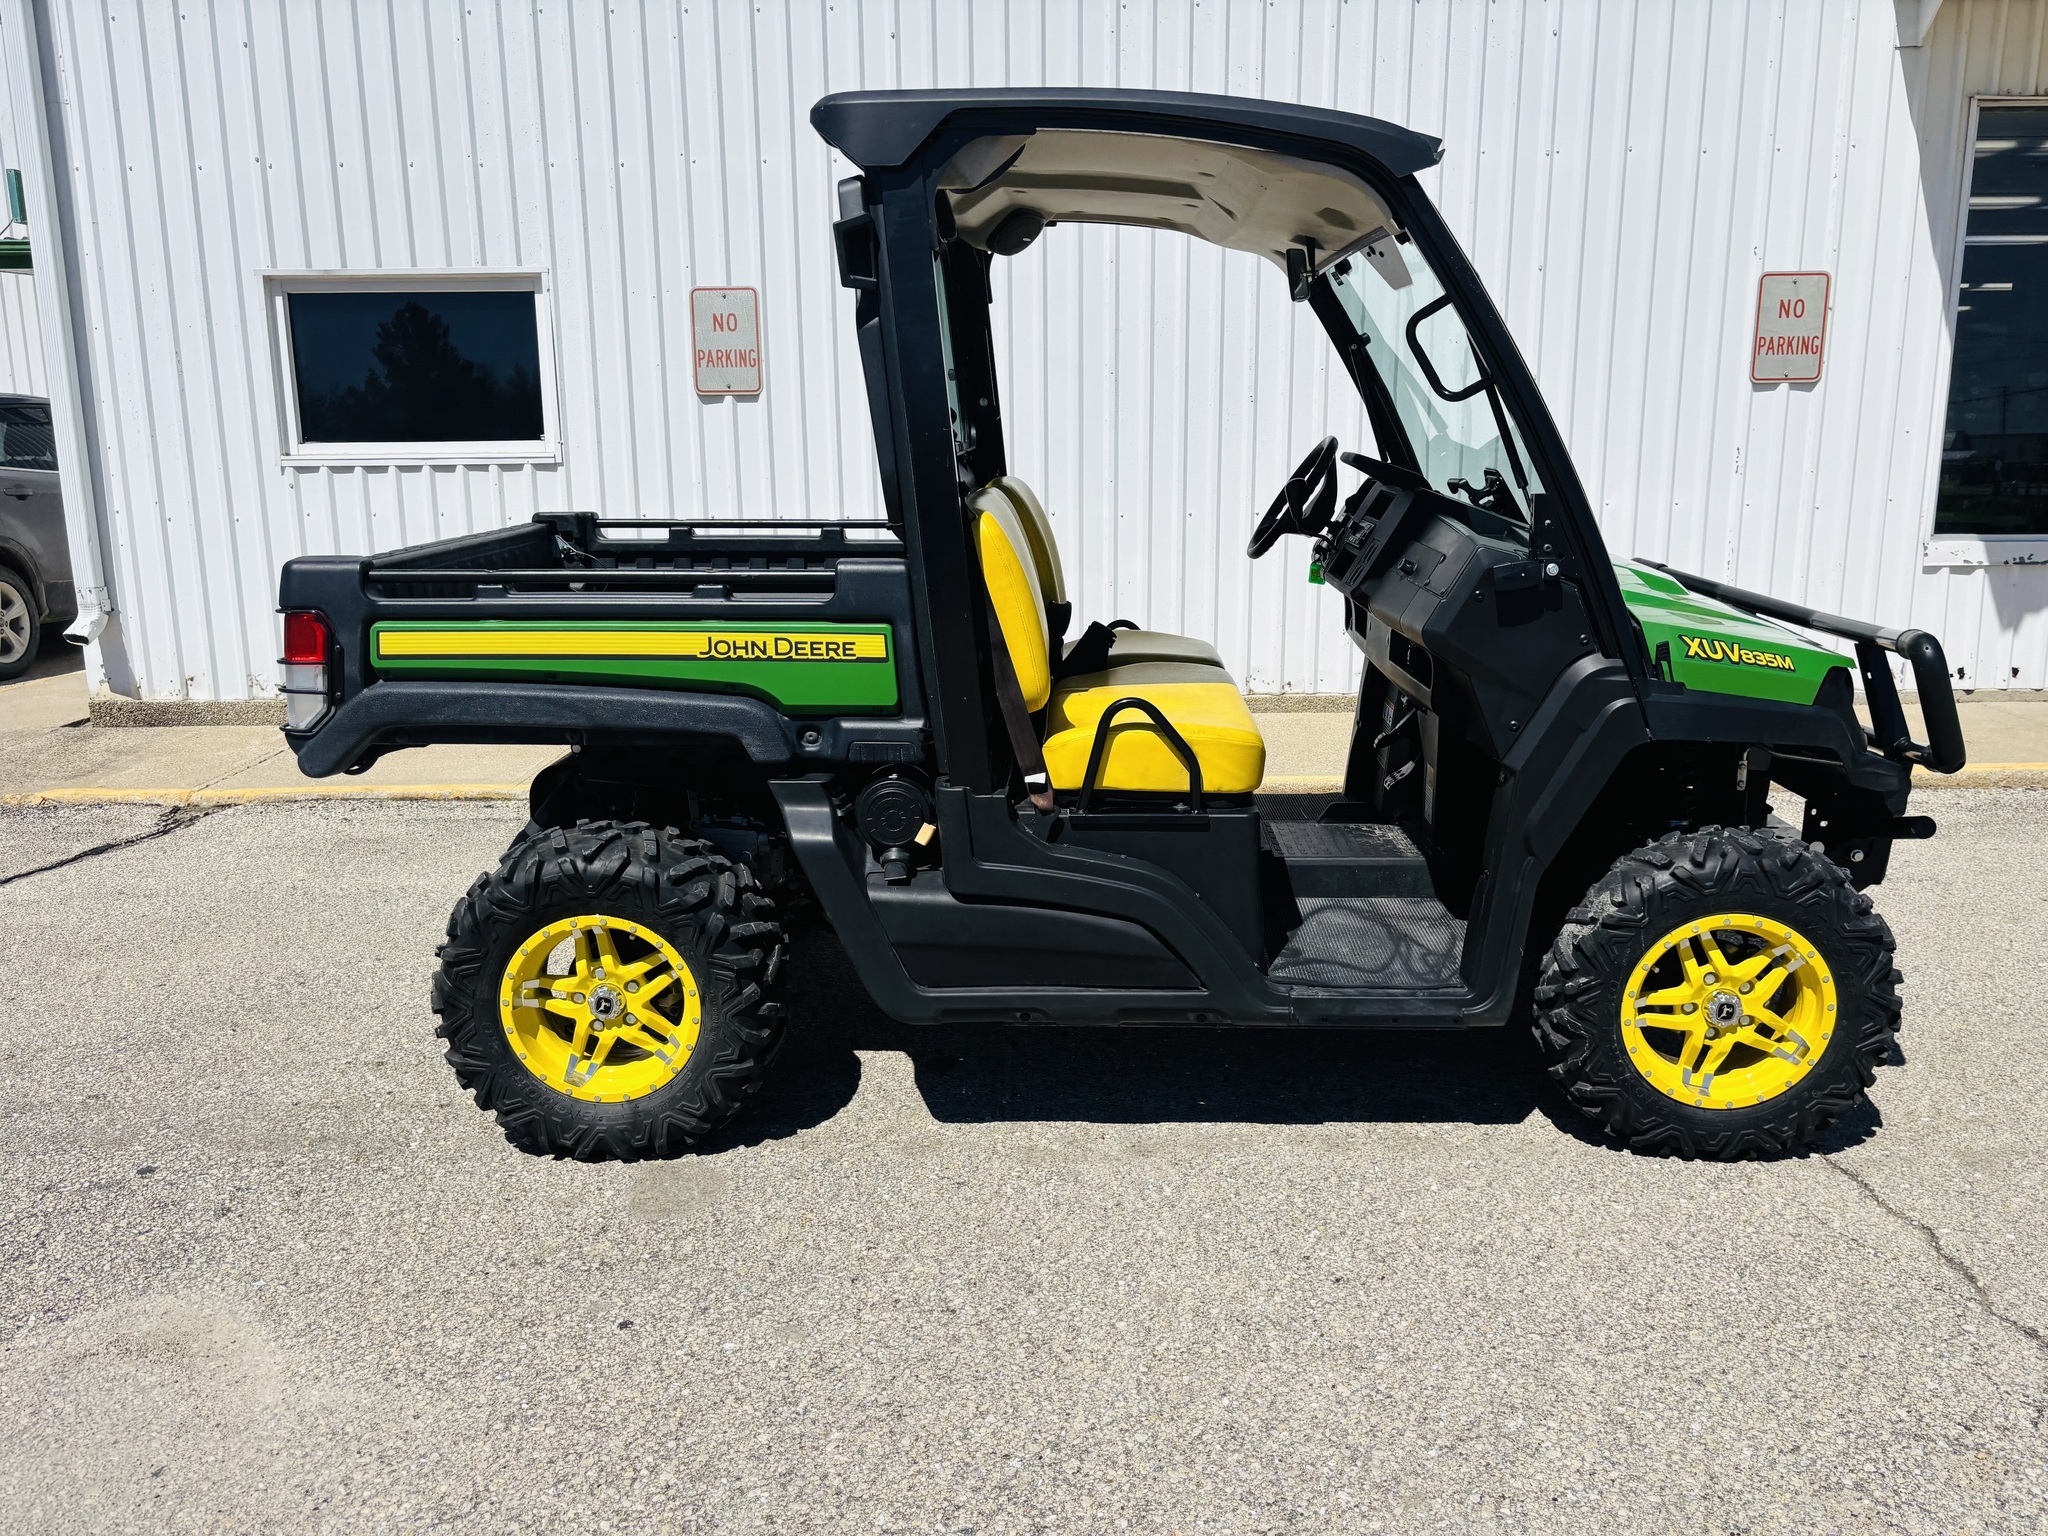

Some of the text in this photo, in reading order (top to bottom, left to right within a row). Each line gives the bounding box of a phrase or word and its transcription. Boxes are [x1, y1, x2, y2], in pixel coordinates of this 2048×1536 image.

[1778, 298, 1805, 319] NO
[712, 312, 738, 332] NO
[1757, 335, 1820, 356] PARKING
[697, 348, 757, 368] PARKING
[699, 636, 857, 657] JOHN DEERE
[1679, 634, 1796, 672] XUV835M
